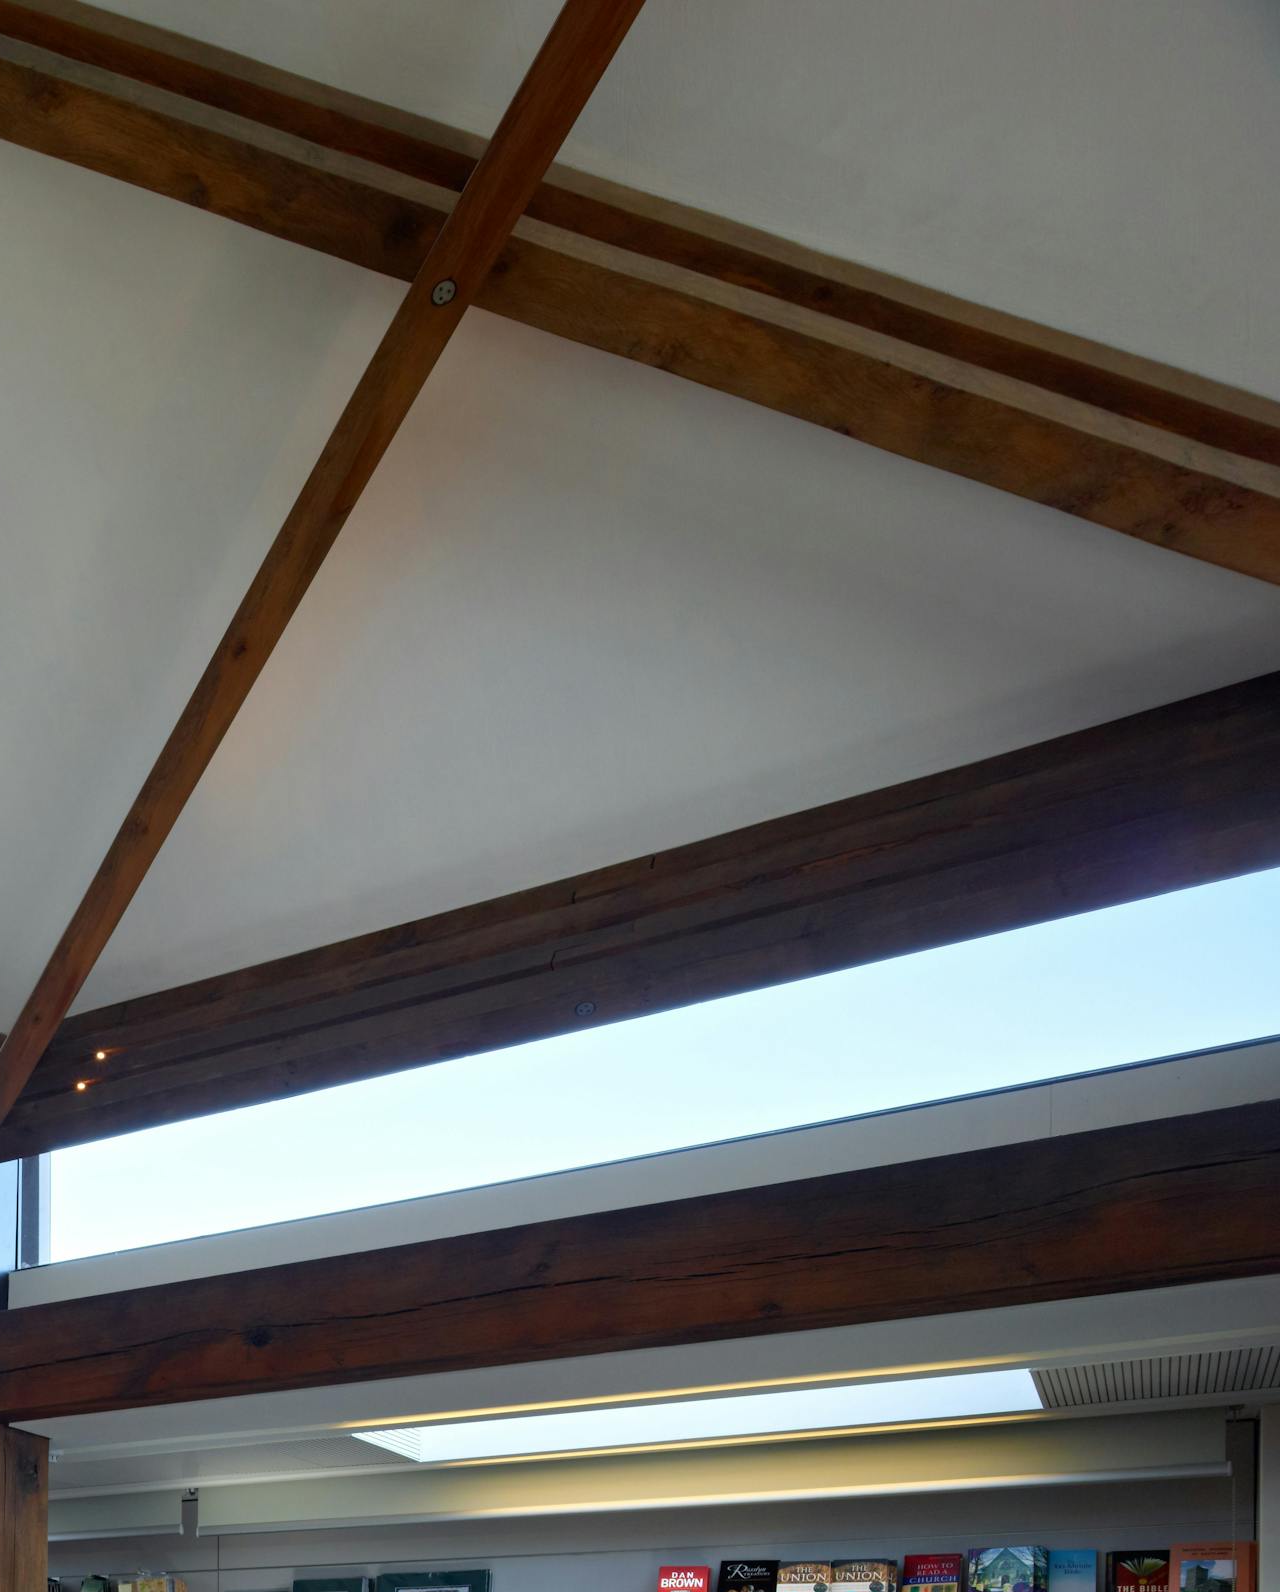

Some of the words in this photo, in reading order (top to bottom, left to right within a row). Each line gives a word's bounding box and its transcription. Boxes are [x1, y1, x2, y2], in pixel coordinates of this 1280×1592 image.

[671, 1571, 694, 1579] DAN
[780, 1572, 827, 1583] UNION
[835, 1571, 883, 1582] UNION
[660, 1578, 703, 1588] BROWN
[909, 1576, 958, 1584] CHURCH
[1117, 1585, 1135, 1592] THE
[1139, 1584, 1169, 1592] BIBLE
